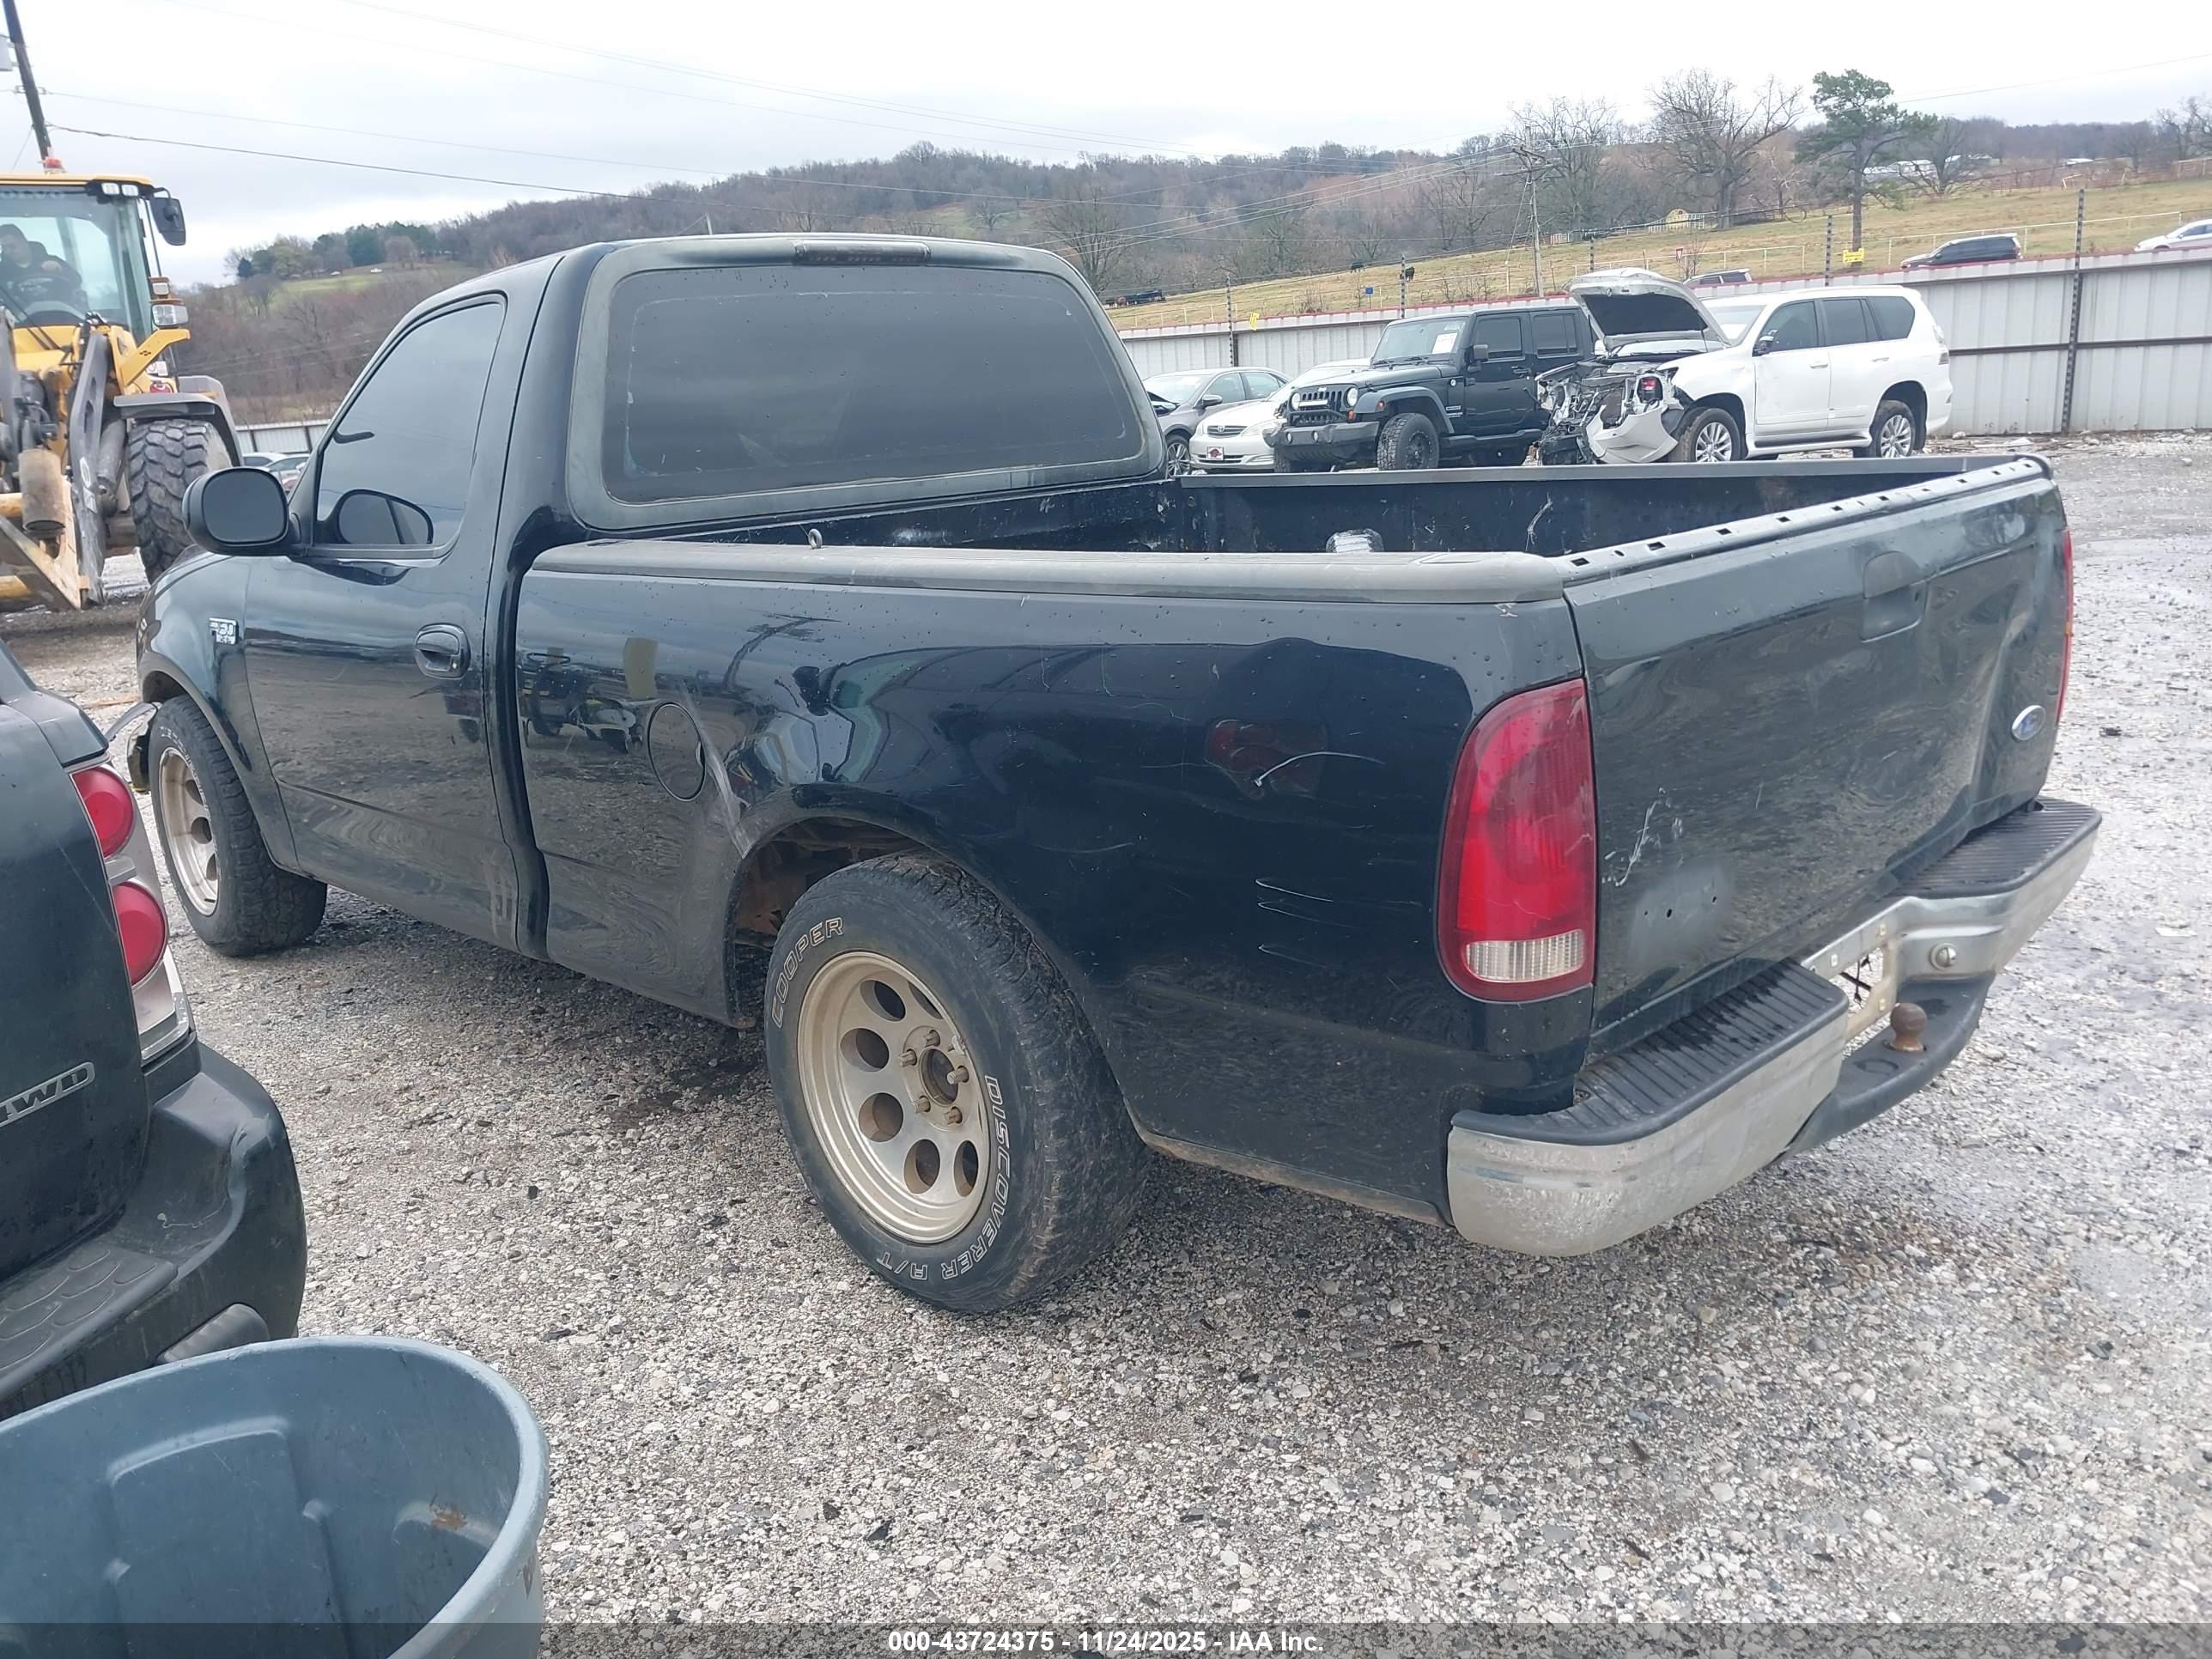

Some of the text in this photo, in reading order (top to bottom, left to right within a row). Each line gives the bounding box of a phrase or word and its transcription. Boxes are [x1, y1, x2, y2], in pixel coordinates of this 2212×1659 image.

[772, 916, 844, 1029] COOPER
[876, 1074, 1011, 1281] DISCOVERER A/T
